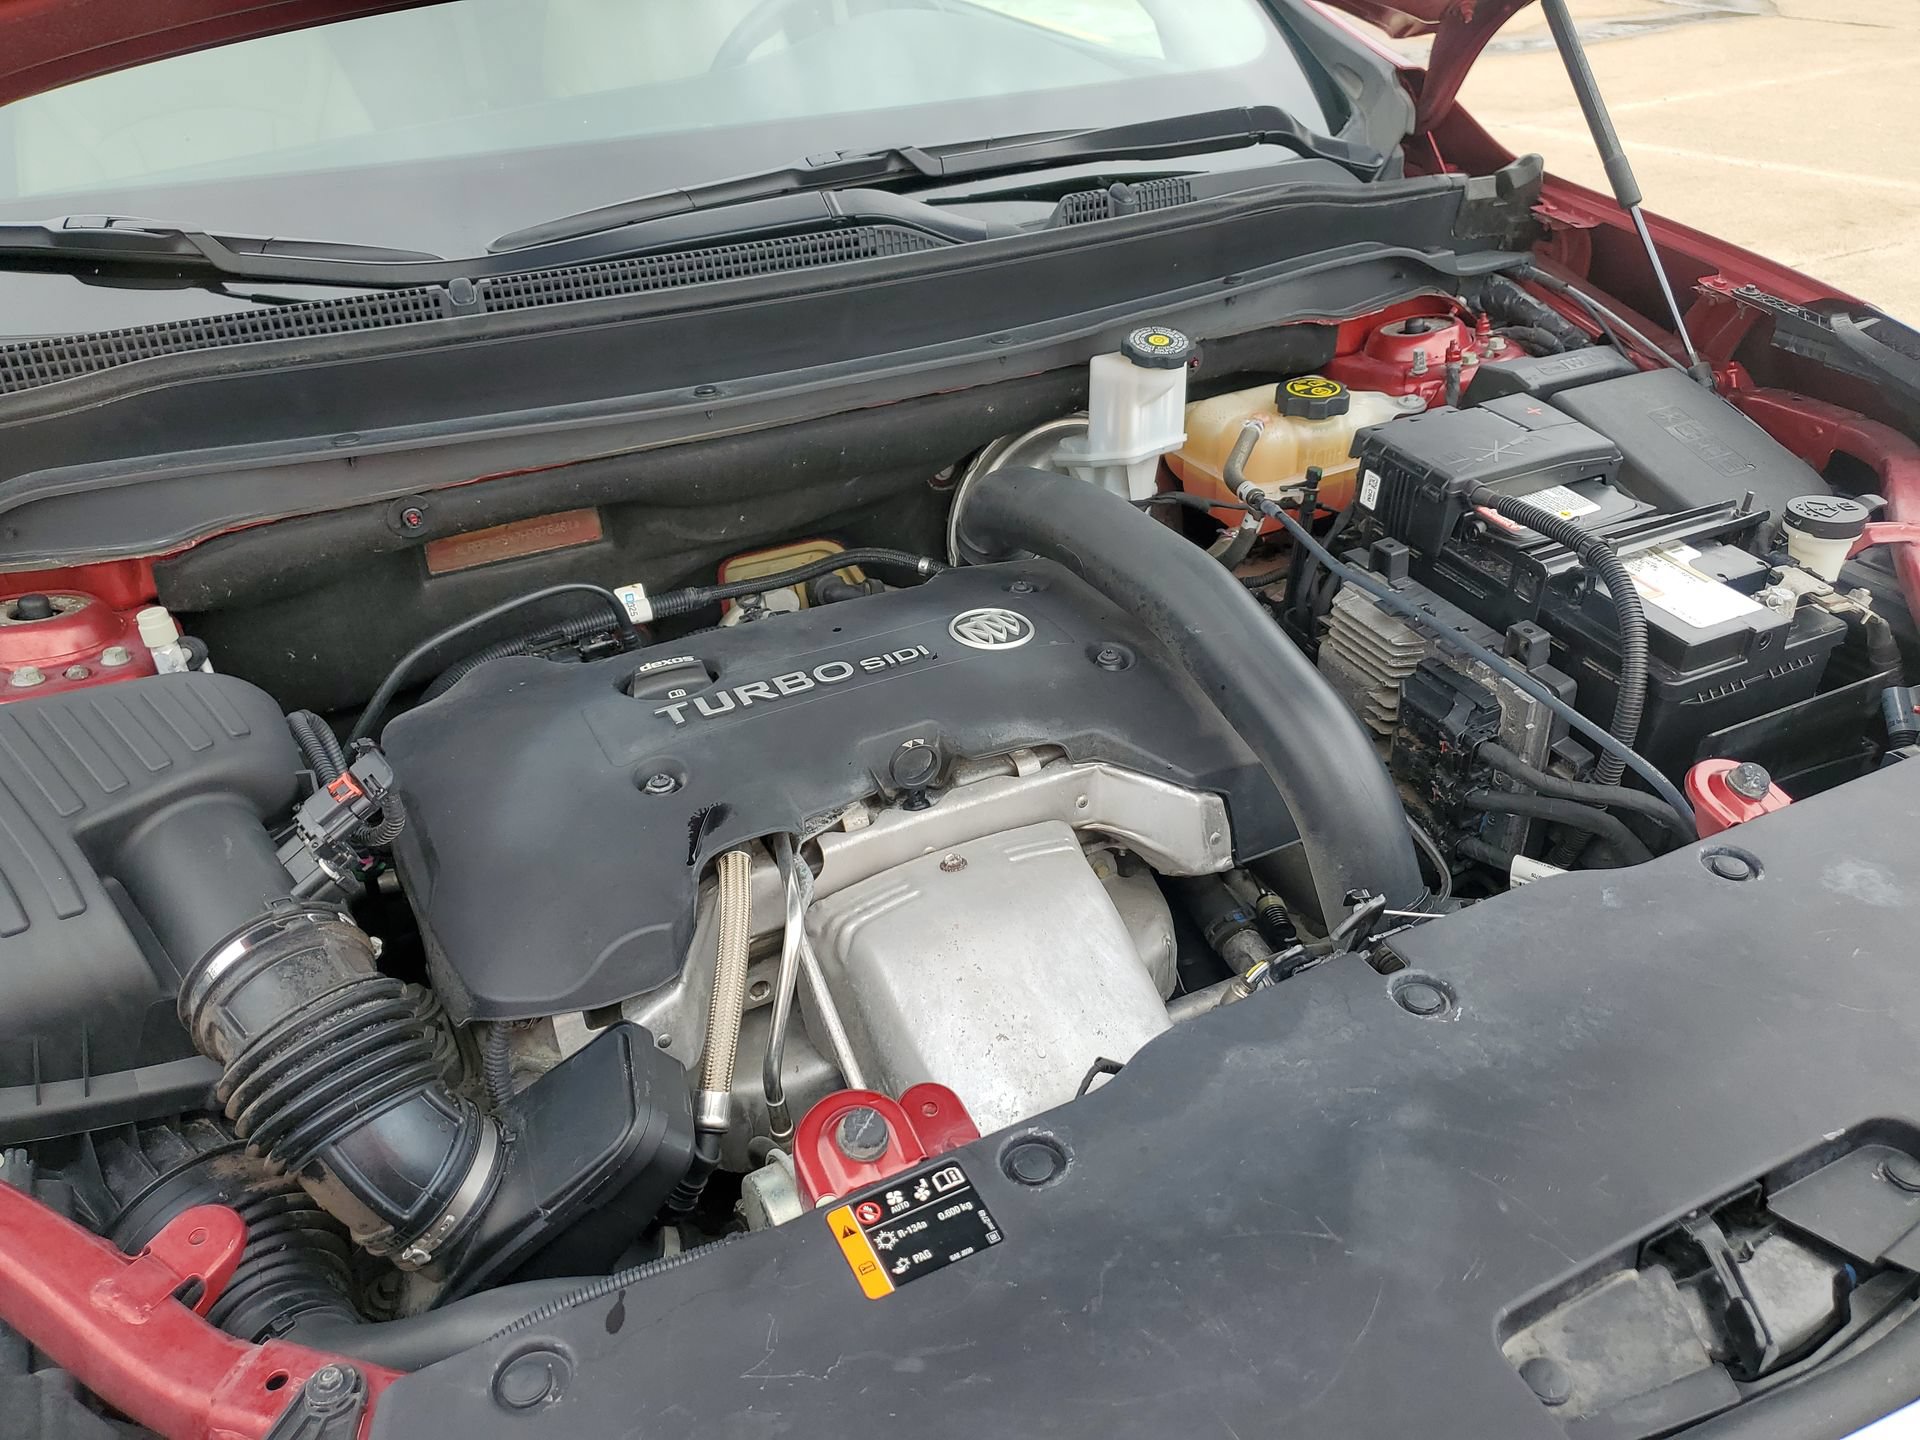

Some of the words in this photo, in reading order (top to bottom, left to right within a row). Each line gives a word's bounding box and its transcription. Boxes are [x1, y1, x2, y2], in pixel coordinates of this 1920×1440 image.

[639, 654, 695, 672] dexos
[653, 660, 855, 725] TURBO
[860, 645, 931, 672] SIDI
[891, 1202, 910, 1214] AUTO
[897, 1221, 928, 1238] R-134a
[960, 1201, 974, 1213] kg
[911, 1249, 933, 1265] PAG
